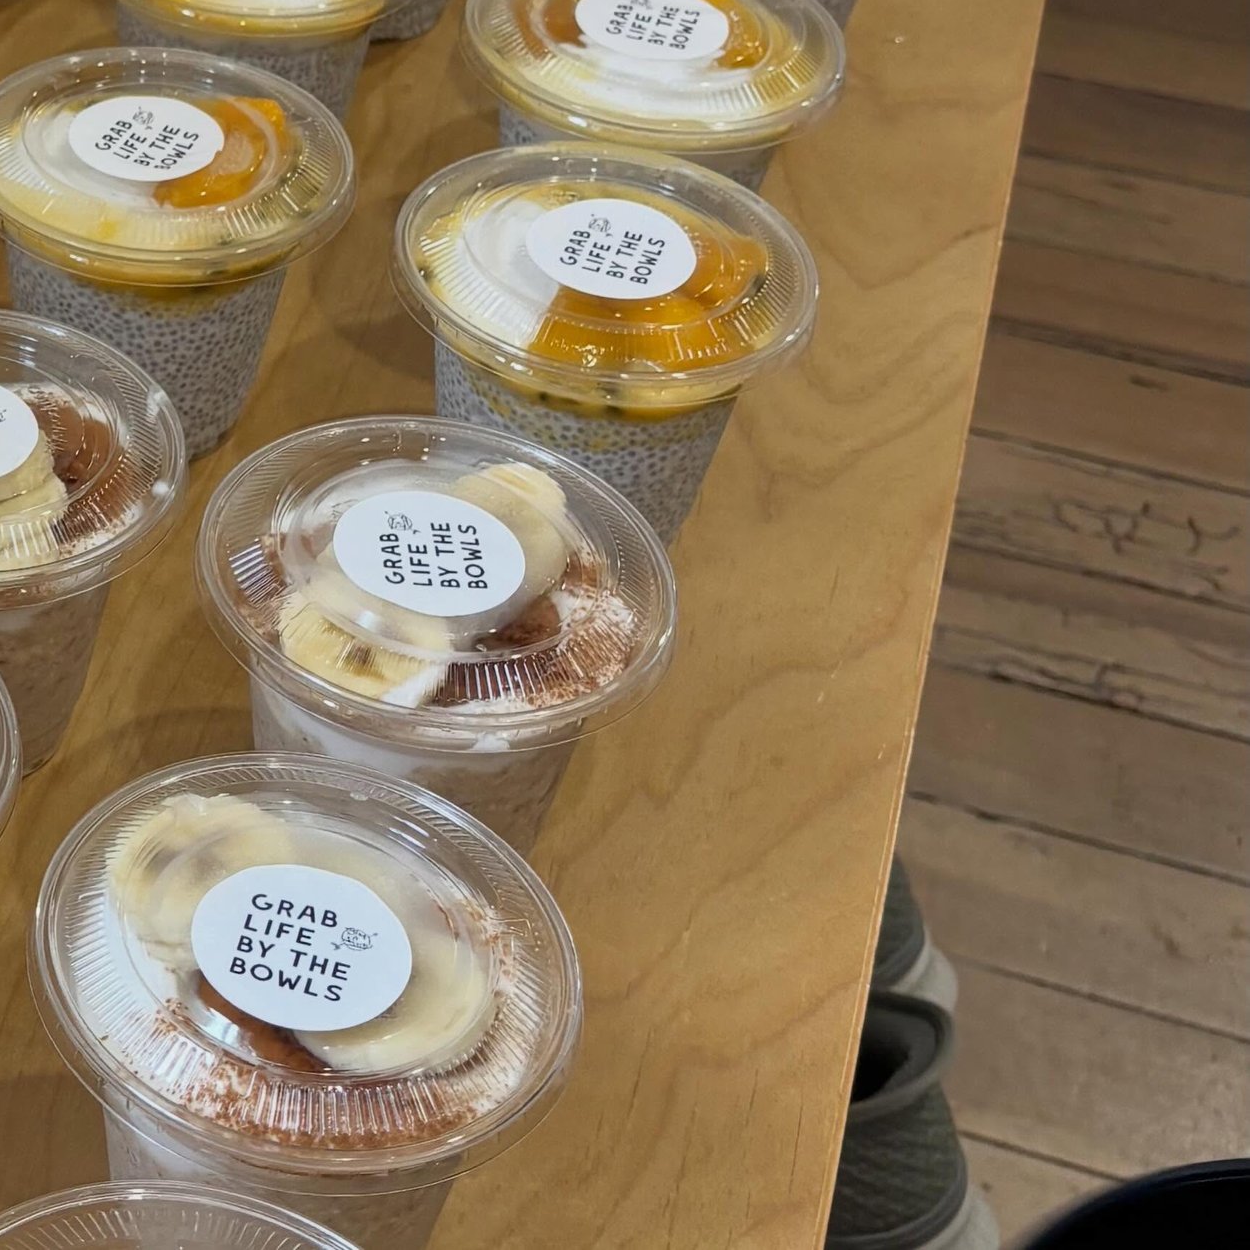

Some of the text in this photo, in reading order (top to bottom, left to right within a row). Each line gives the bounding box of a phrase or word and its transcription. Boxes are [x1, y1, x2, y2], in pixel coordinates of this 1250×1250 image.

[606, 4, 633, 35] GRAB
[627, 13, 652, 40] LIFE
[648, 6, 680, 45] BY THE
[670, 9, 701, 50] BOWLS
[96, 119, 133, 151] GRAB
[116, 132, 147, 160] LIFE
[134, 125, 180, 167] BY THE
[154, 133, 199, 170] BOWLS
[560, 230, 591, 265] GRAB
[582, 243, 611, 272] LIFE
[606, 231, 643, 279] BY THE
[630, 238, 665, 284] BOWLS
[380, 533, 405, 585] GRAB
[407, 543, 432, 587] LIFE
[431, 522, 460, 588] BY THE
[458, 524, 488, 589] BOWLS
[244, 914, 313, 945] LIFE
[251, 893, 338, 928] GRAB
[237, 935, 352, 981] BY THE
[230, 957, 342, 1002] BOWLS
